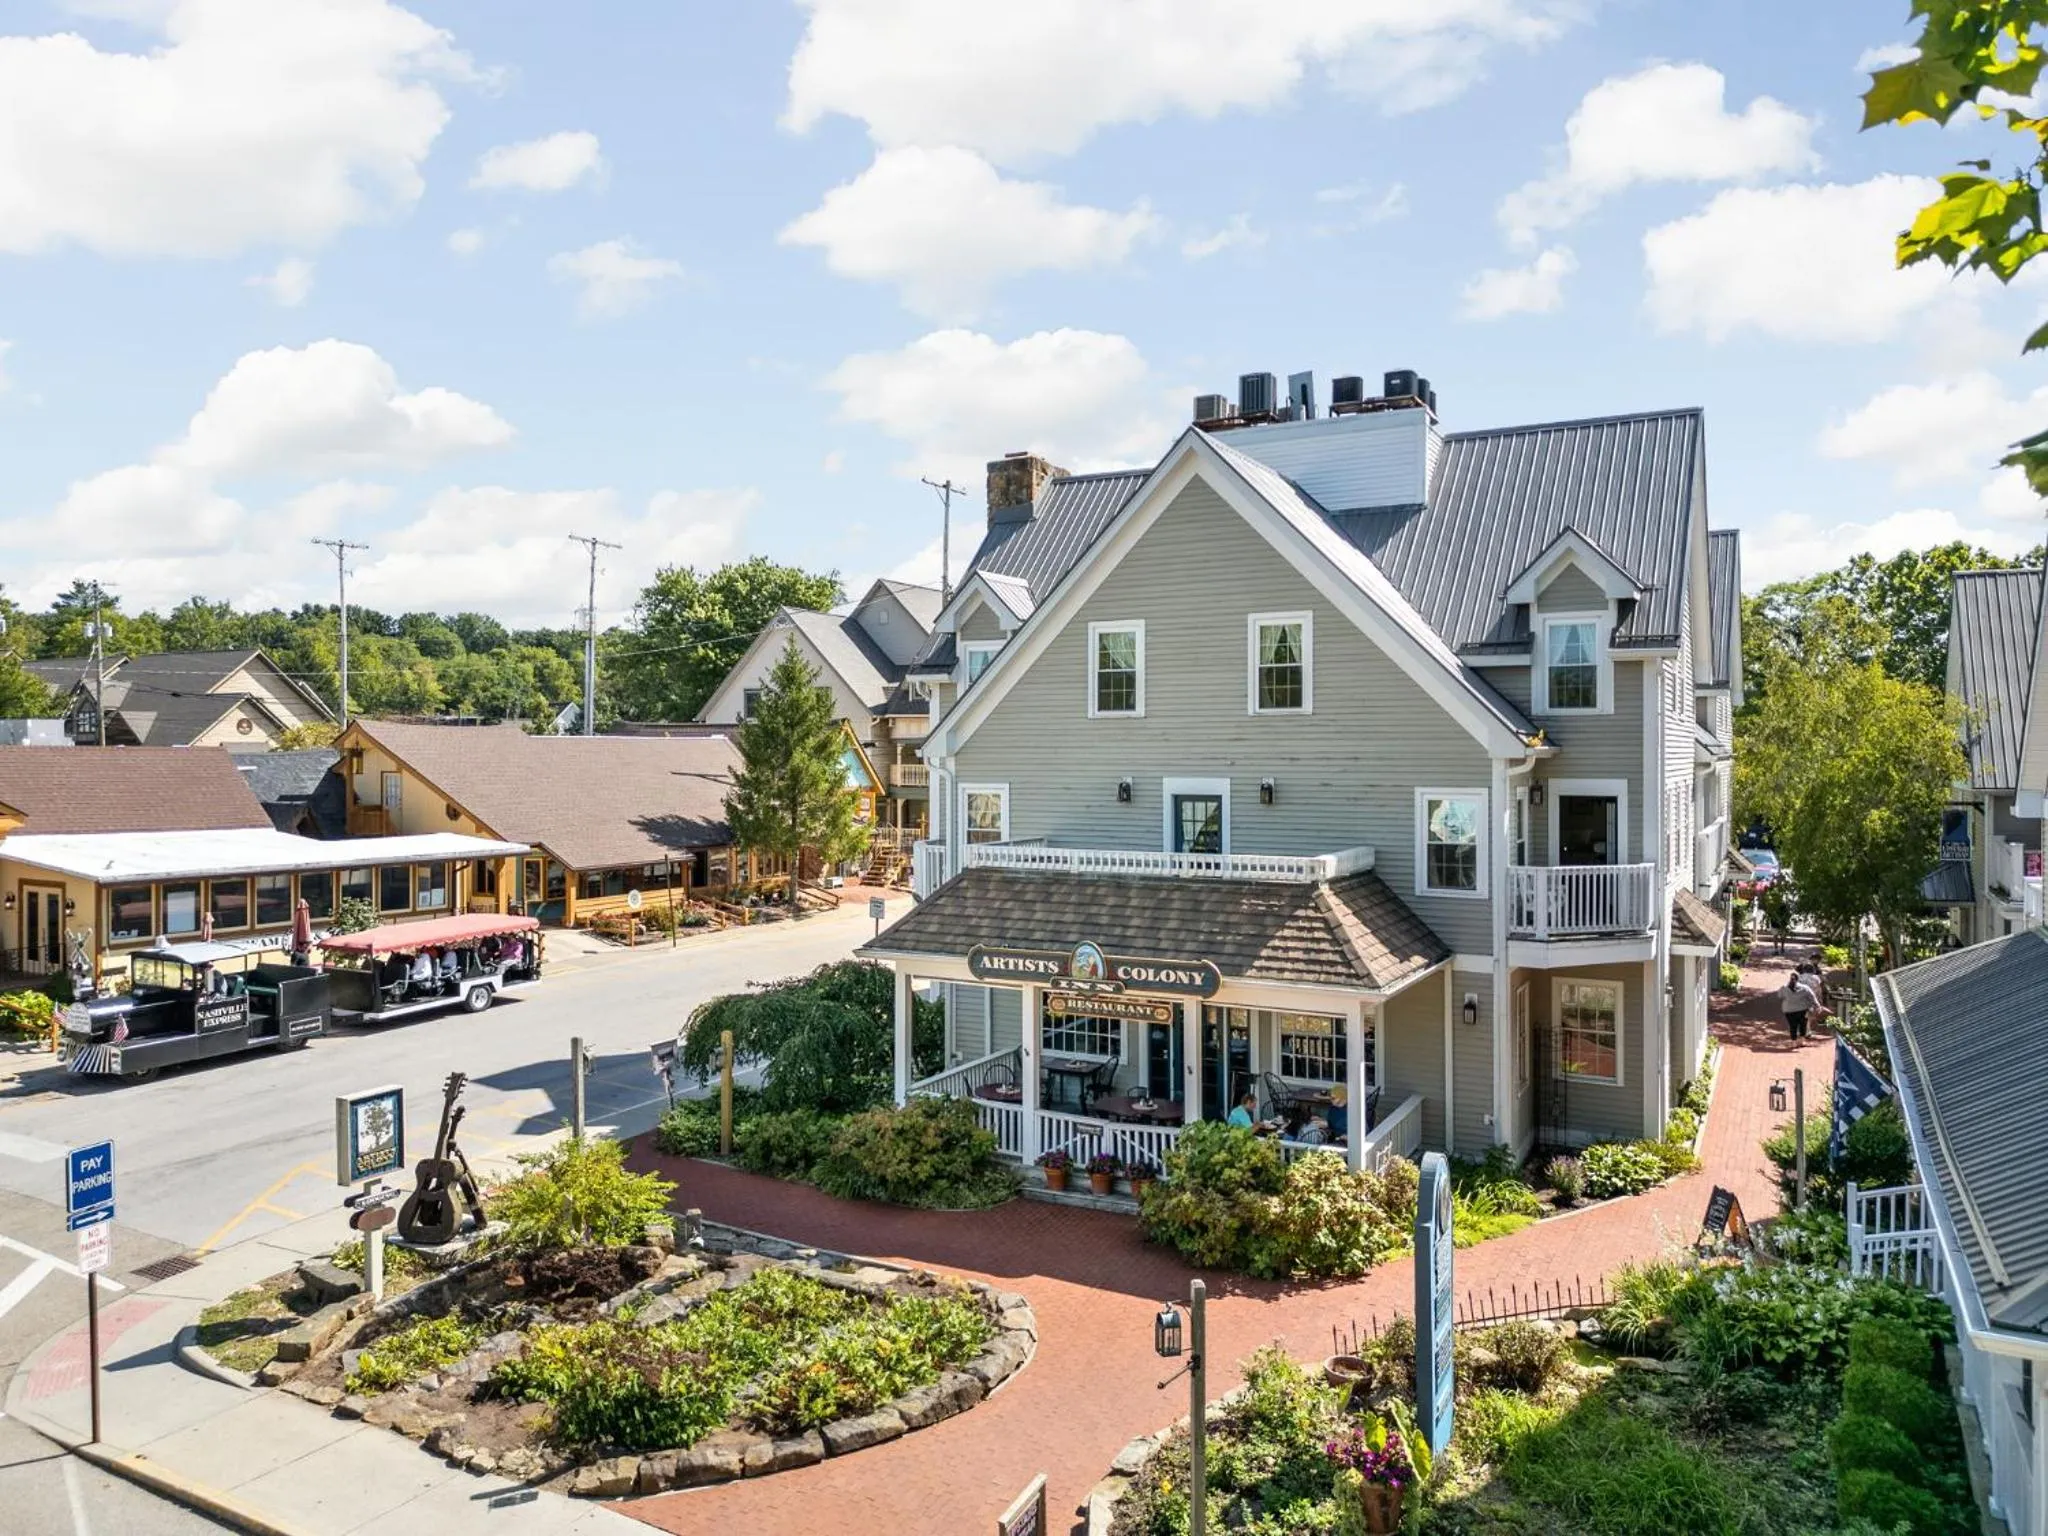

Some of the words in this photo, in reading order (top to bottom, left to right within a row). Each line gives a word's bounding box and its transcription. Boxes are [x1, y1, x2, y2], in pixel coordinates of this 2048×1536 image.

[980, 955, 1059, 974] ARTISTS
[1117, 966, 1205, 986] COLONY
[1058, 980, 1116, 993] INN
[197, 1003, 248, 1019] NASHVILLE
[1067, 998, 1154, 1016] RESTAURANT
[203, 1013, 242, 1027] EXPRESS
[80, 1155, 103, 1173] PAY
[72, 1172, 112, 1195] PARKING
